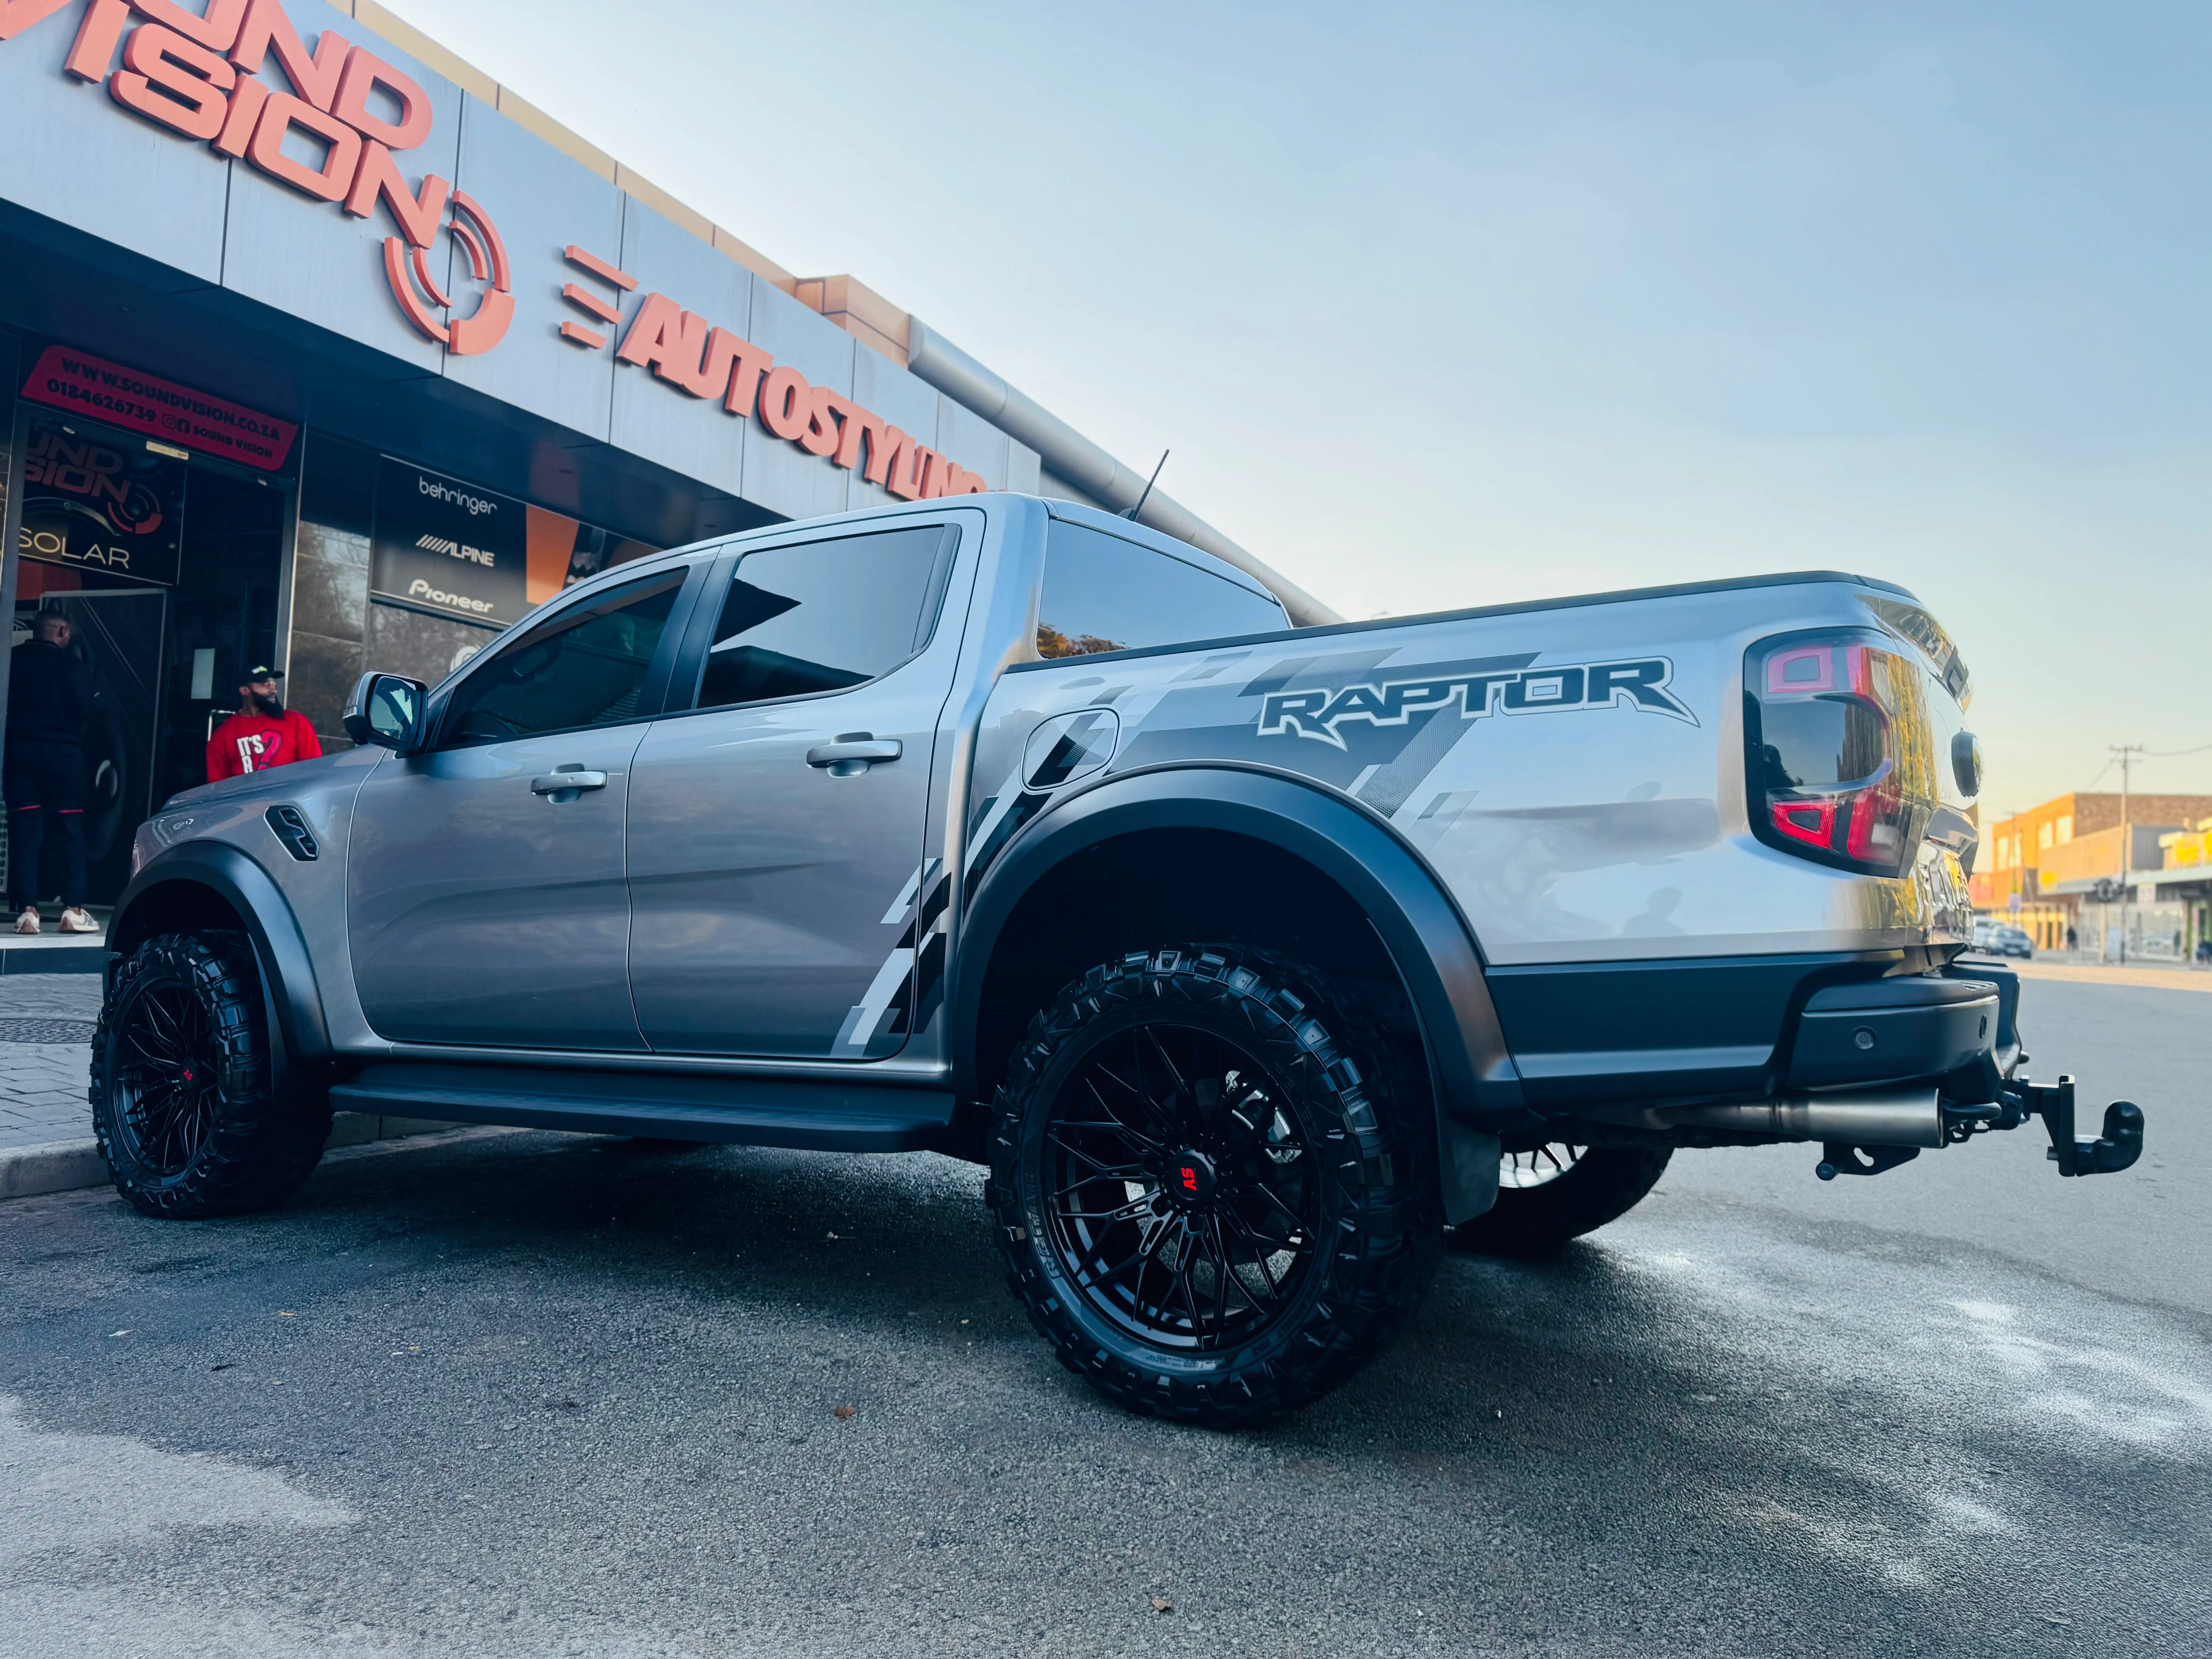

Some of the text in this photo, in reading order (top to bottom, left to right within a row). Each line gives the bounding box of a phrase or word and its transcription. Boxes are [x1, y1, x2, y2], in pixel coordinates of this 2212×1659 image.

[47, 378, 273, 459] 0184626739 SOUND VISION
[62, 358, 280, 441] WWW.SOUNDVISION.CO.ZA
[419, 476, 497, 515] behringer
[19, 527, 130, 569] SOLAR
[441, 541, 495, 567] ALPINE
[409, 579, 494, 613] Pioneer
[1257, 656, 1701, 751] RAPTOR
[237, 734, 264, 757] IT'S
[1180, 1167, 1197, 1191] AS
